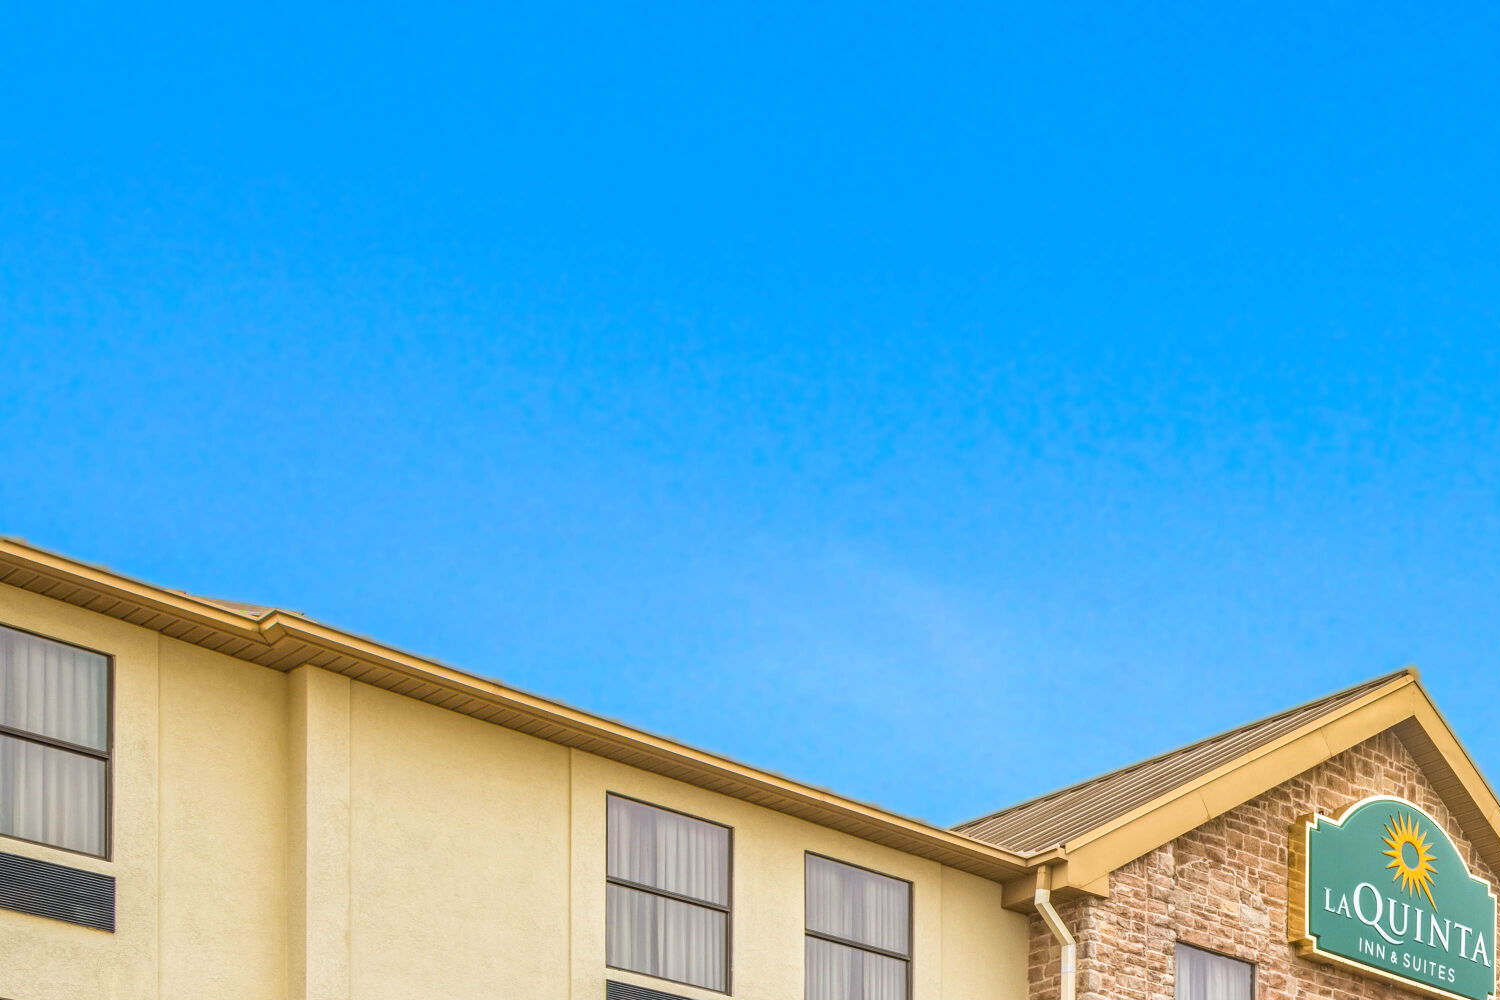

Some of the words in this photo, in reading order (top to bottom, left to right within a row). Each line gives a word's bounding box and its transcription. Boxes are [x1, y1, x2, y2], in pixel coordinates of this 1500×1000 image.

[1359, 937, 1385, 960] INN
[1390, 951, 1398, 964] &
[1403, 953, 1456, 983] SUITES
